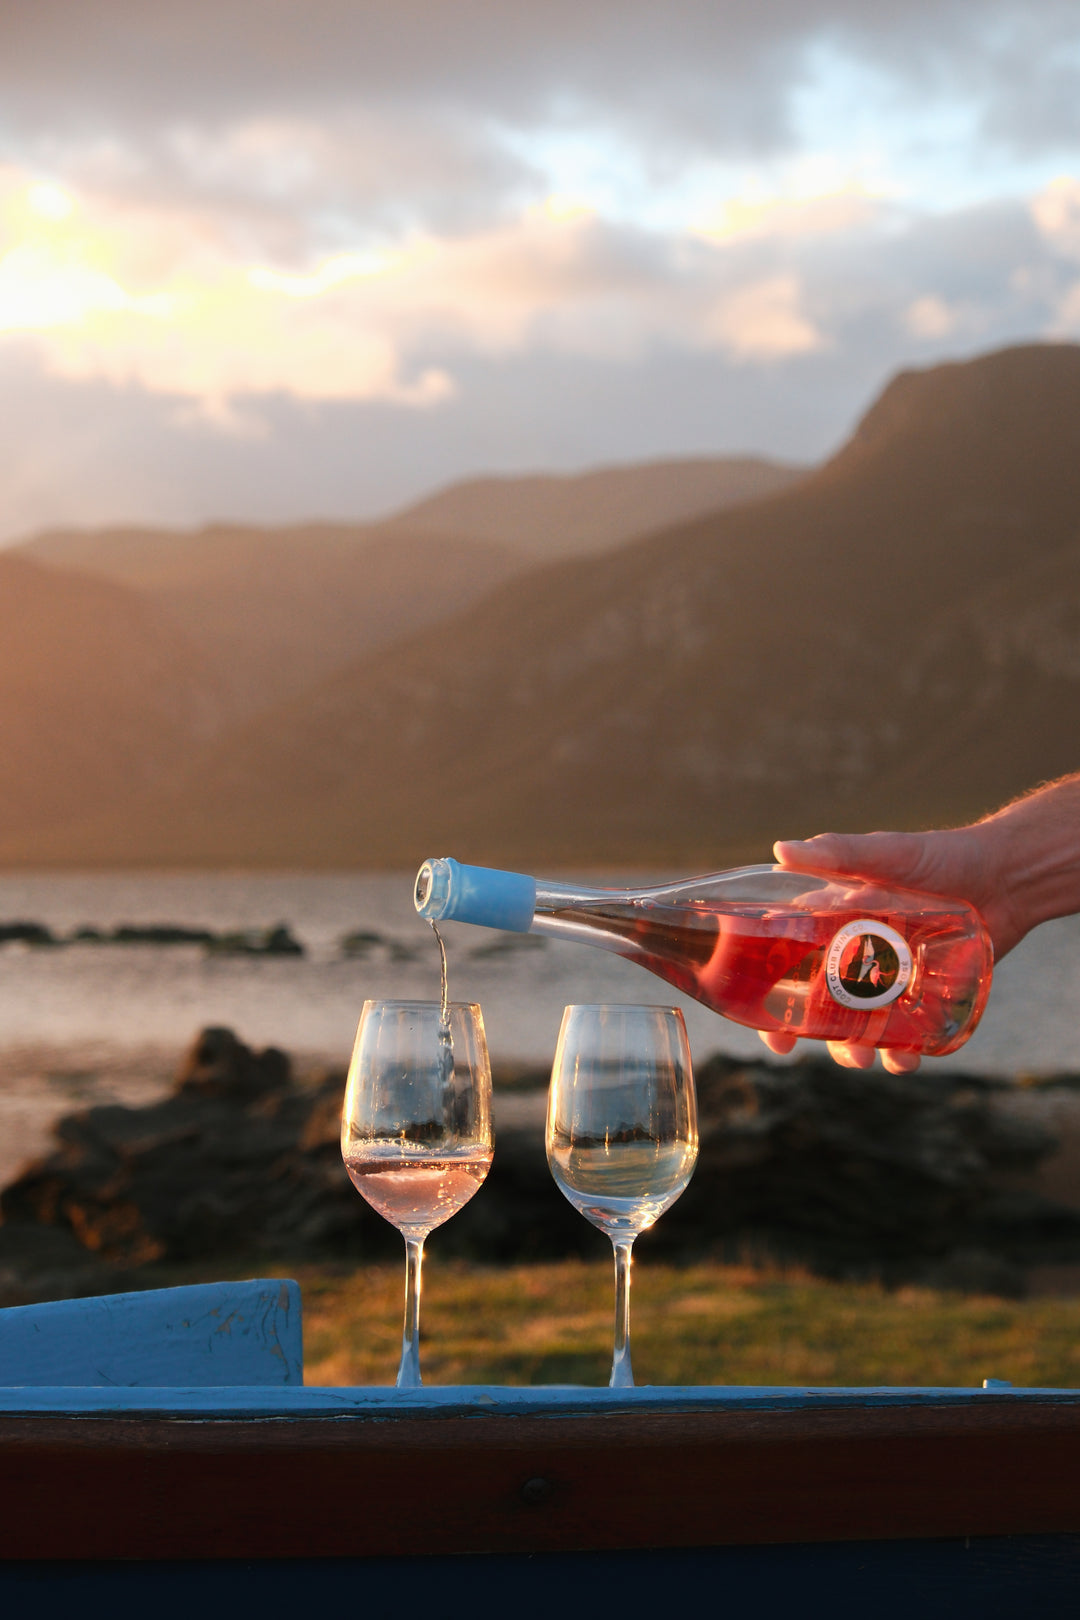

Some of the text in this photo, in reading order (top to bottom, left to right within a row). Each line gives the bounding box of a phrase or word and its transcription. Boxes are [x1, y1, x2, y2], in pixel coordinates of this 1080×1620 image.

[834, 930, 851, 952] WINE
[829, 956, 839, 982] CLUB
[832, 985, 851, 1003] COOT
